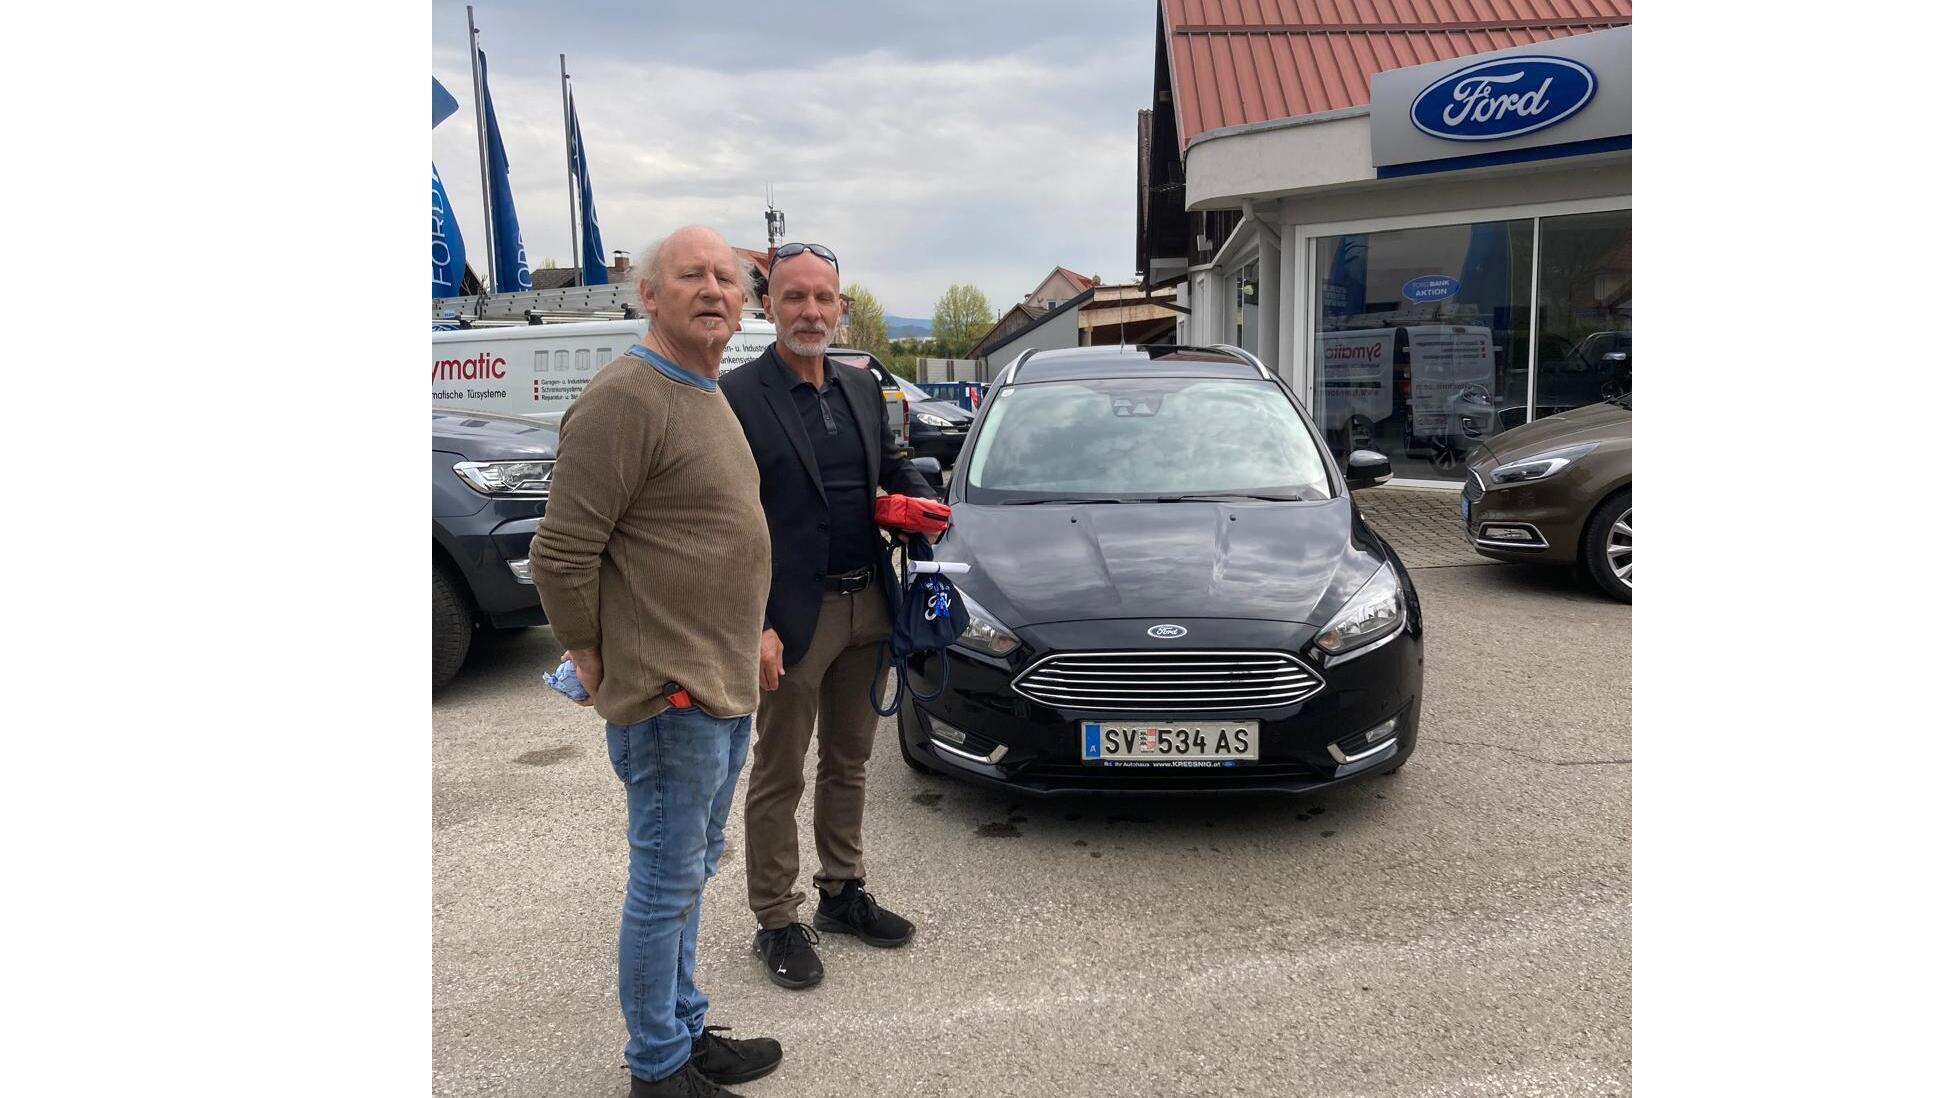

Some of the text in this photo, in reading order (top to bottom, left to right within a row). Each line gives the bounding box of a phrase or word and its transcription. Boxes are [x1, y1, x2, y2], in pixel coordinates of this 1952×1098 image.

[1443, 71, 1553, 126] Ford
[432, 189, 451, 286] FORD
[1415, 288, 1447, 297] AKTION
[467, 389, 507, 400] Türsysteme
[1105, 728, 1249, 754] SV 534 AS
